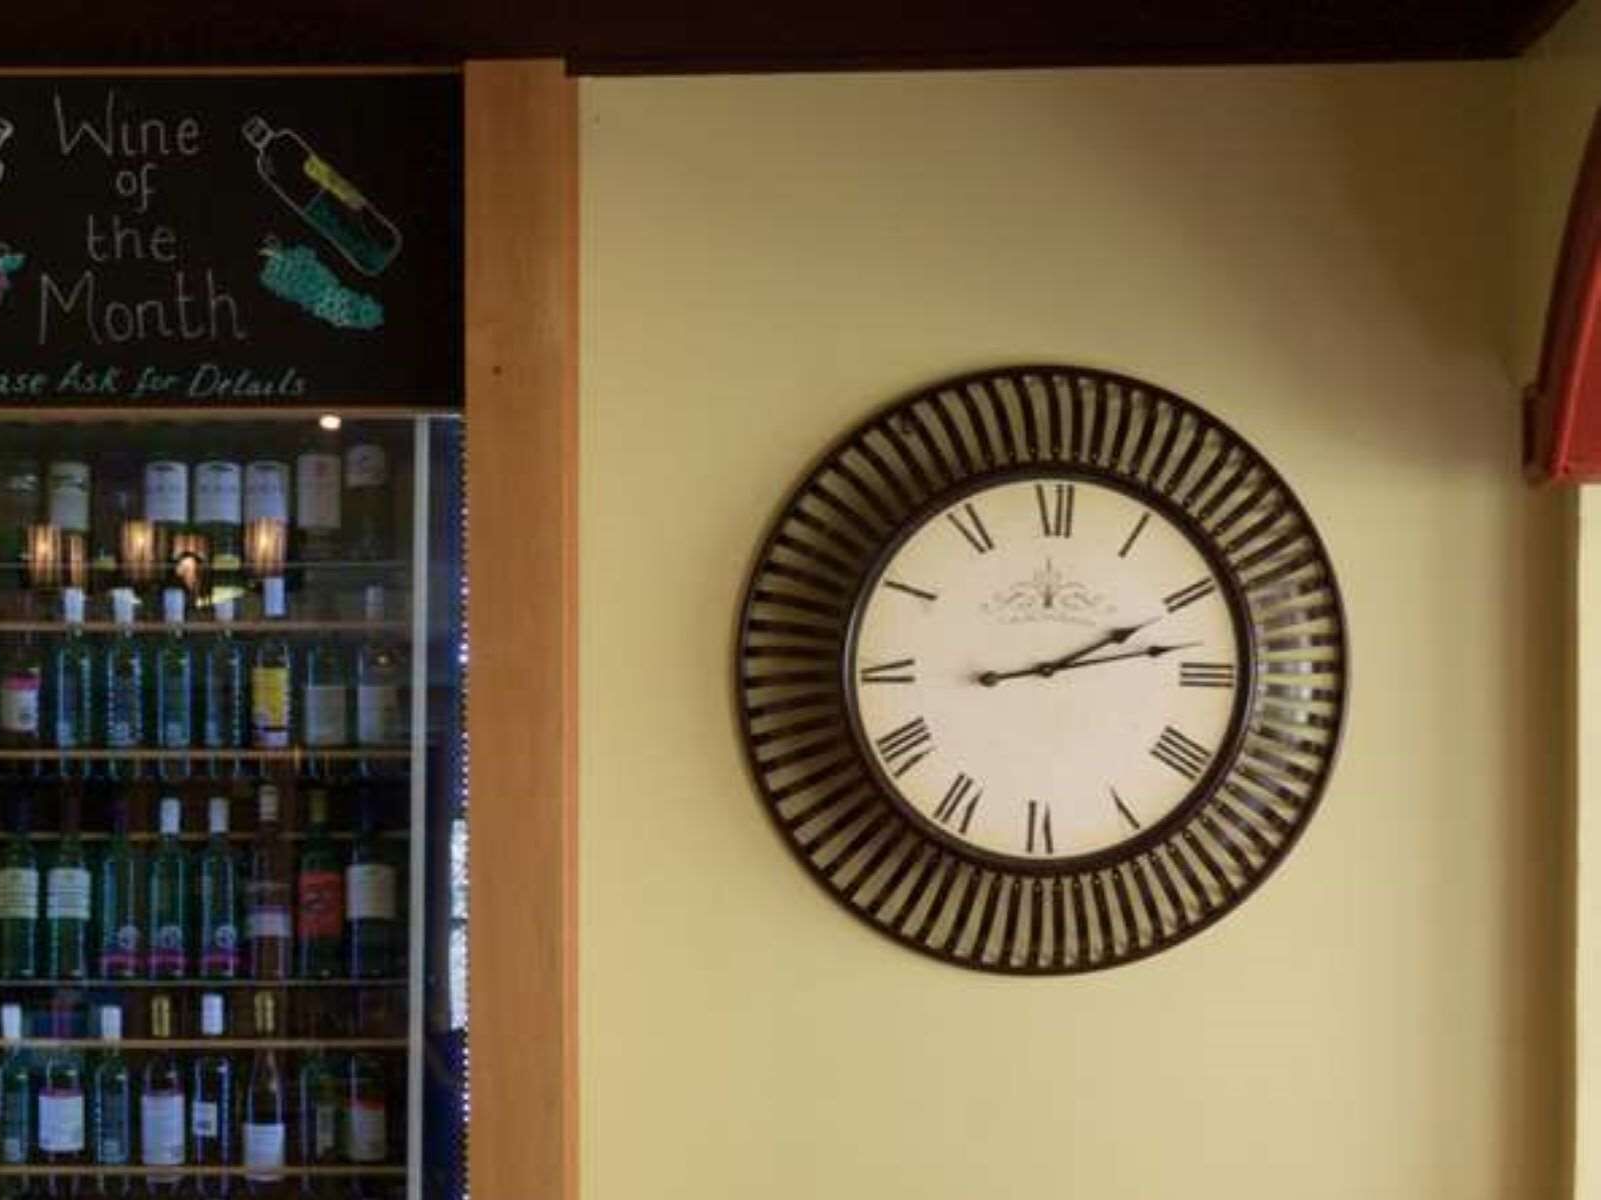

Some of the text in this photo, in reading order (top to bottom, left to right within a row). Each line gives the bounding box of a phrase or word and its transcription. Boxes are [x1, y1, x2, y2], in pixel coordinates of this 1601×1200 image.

[53, 89, 201, 157] Wine
[115, 162, 156, 212] of
[85, 213, 179, 263] the
[38, 269, 248, 345] Month
[56, 360, 122, 395] Ask
[128, 364, 180, 400] for
